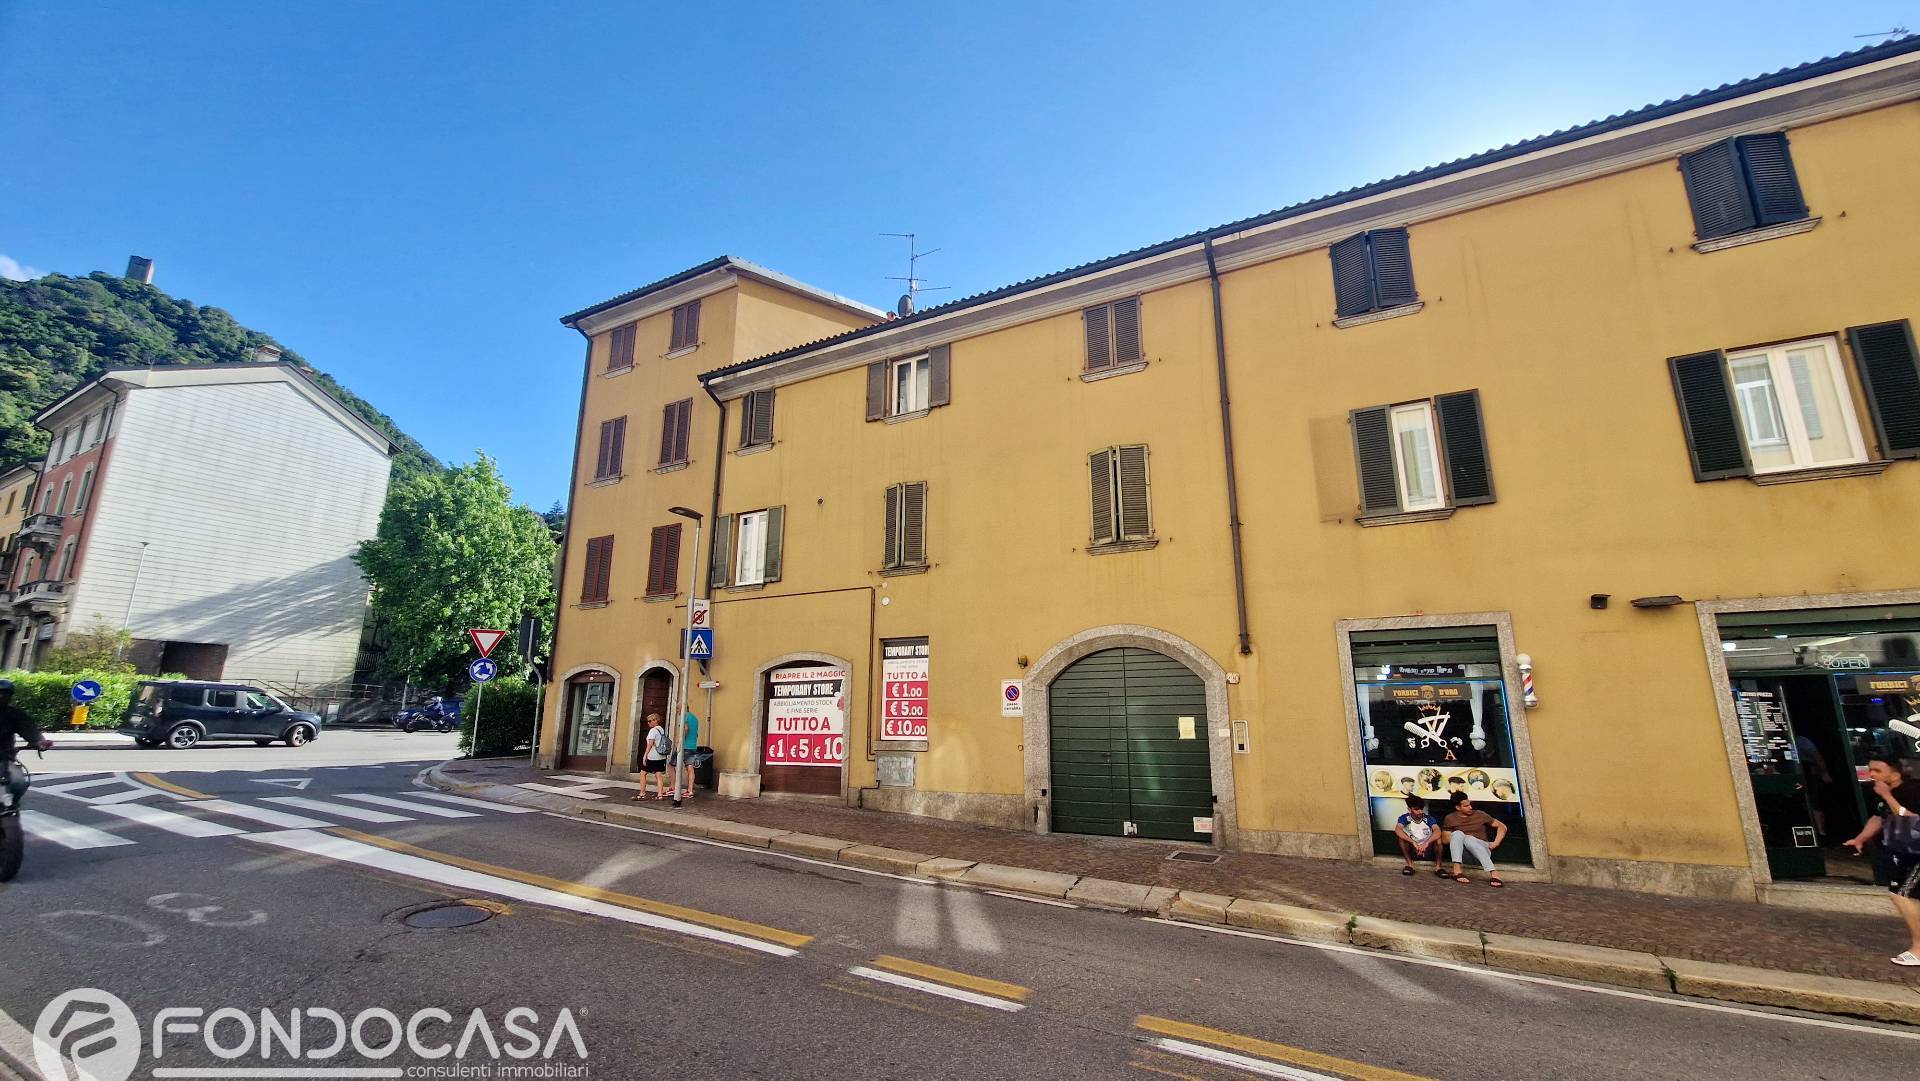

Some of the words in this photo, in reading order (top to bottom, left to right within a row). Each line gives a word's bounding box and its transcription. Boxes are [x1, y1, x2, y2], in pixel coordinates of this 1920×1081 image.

[885, 645, 914, 657] TEMPORARY
[915, 644, 928, 656] STOR
[1831, 658, 1867, 668] OPEN
[775, 672, 800, 680] RIAPRE
[887, 671, 918, 680] TUTTO
[920, 671, 928, 679] A
[773, 683, 812, 697] TEMPORARY
[813, 682, 834, 696] STORE
[902, 683, 922, 697] 1.00
[901, 701, 923, 716] 5.00
[775, 716, 819, 731] TUTTO
[820, 716, 831, 731] A
[896, 719, 926, 736] 10.00
